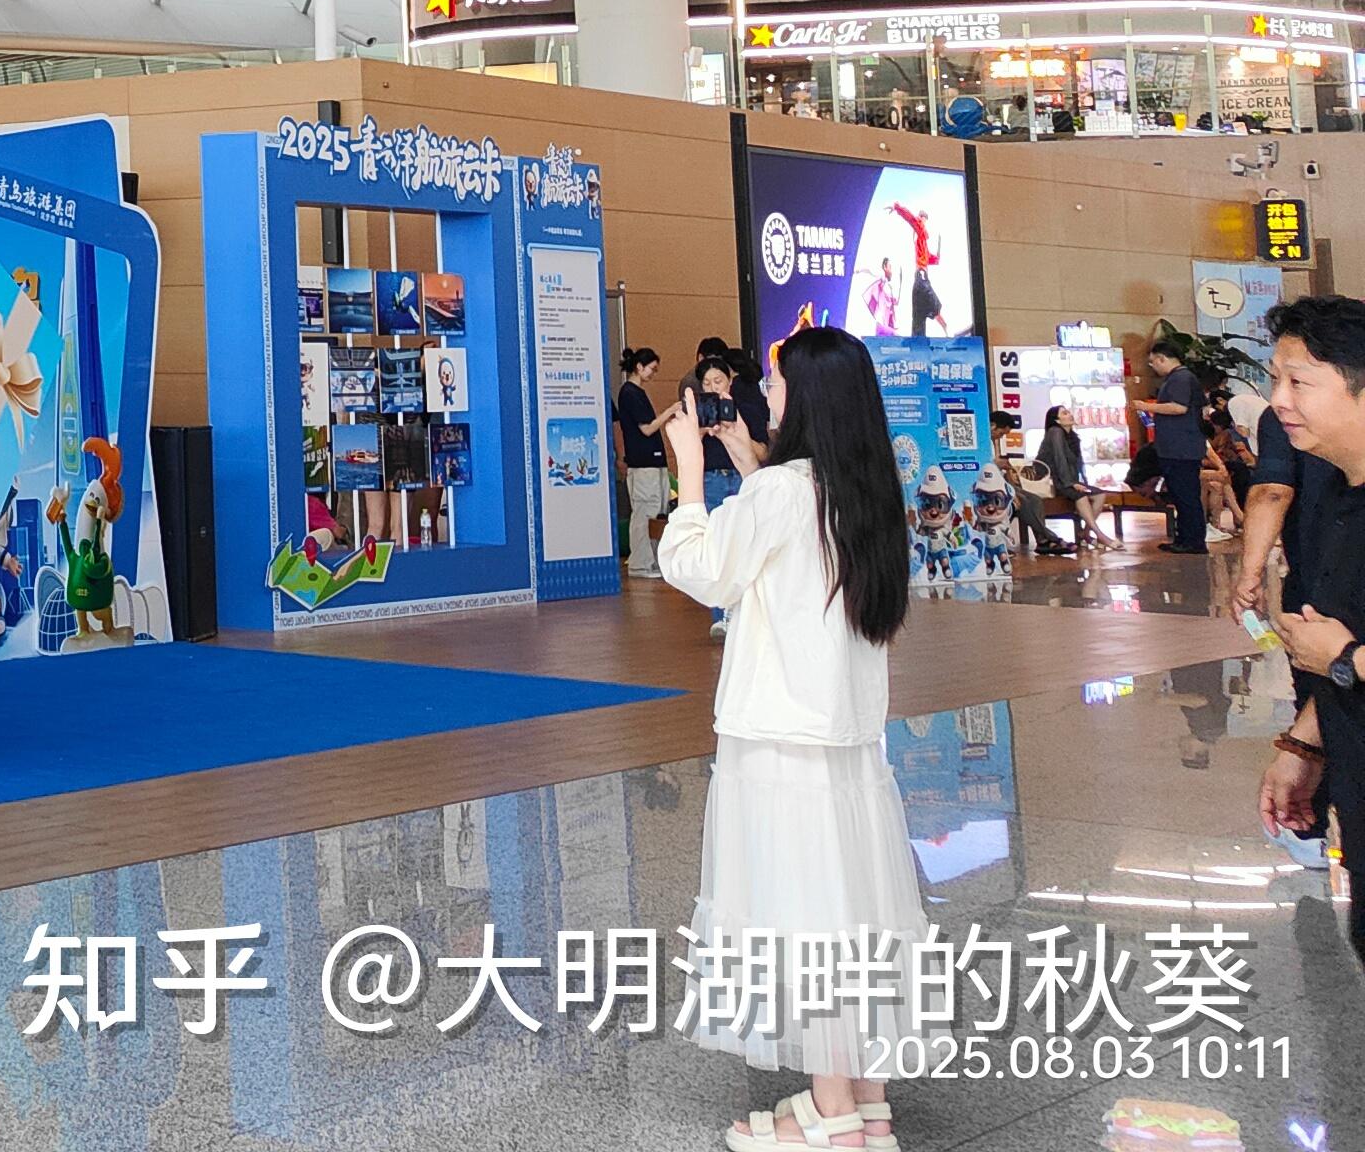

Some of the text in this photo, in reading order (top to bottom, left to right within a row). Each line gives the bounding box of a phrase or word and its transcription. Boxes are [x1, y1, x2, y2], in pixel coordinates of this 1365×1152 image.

[886, 13, 1000, 29] CHARGRILLED
[773, 20, 868, 47] Carl's Jr.
[1249, 77, 1289, 86] SCOOPE
[1221, 98, 1243, 110] ICE
[1267, 203, 1298, 217] 开包
[795, 224, 844, 250] TARANIS
[1288, 245, 1301, 258] N
